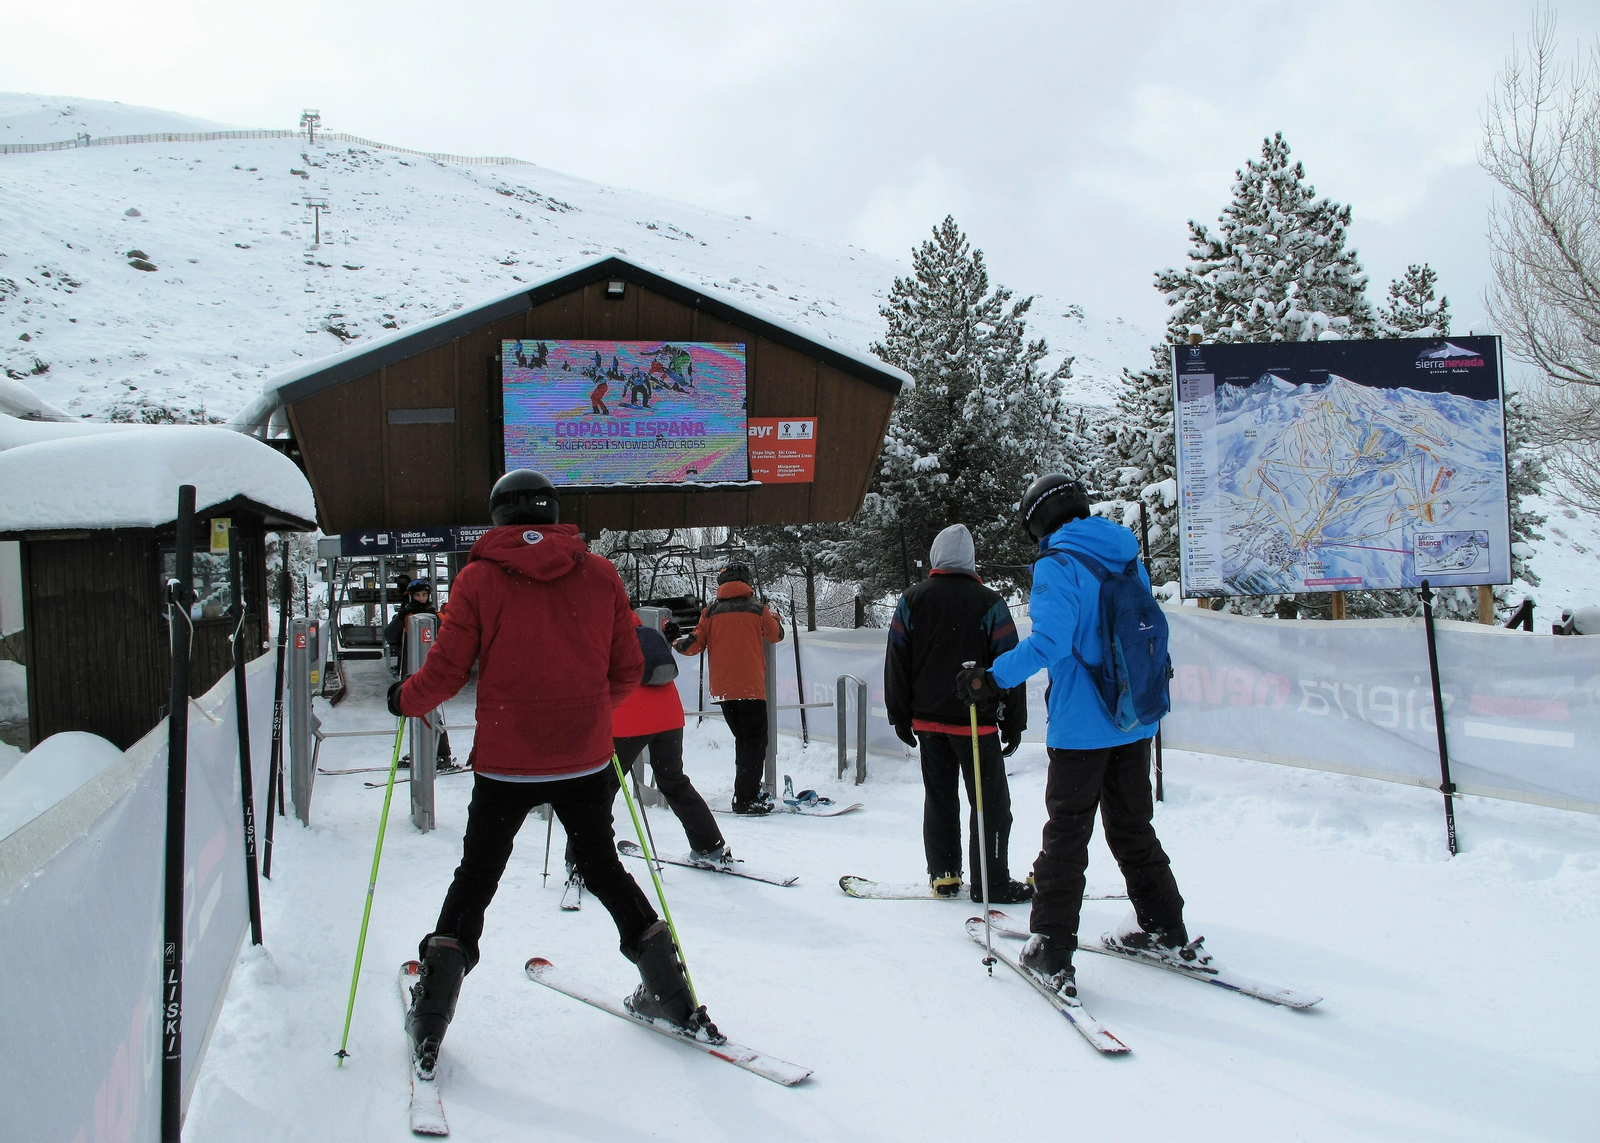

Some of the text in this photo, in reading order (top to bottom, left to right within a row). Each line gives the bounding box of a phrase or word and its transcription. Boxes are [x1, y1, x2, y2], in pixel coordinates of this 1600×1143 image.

[555, 417, 707, 437] COPA DE ESPAÑA
[613, 439, 706, 450] SNOWBOARDCROSS
[166, 969, 179, 1052] LISKI
